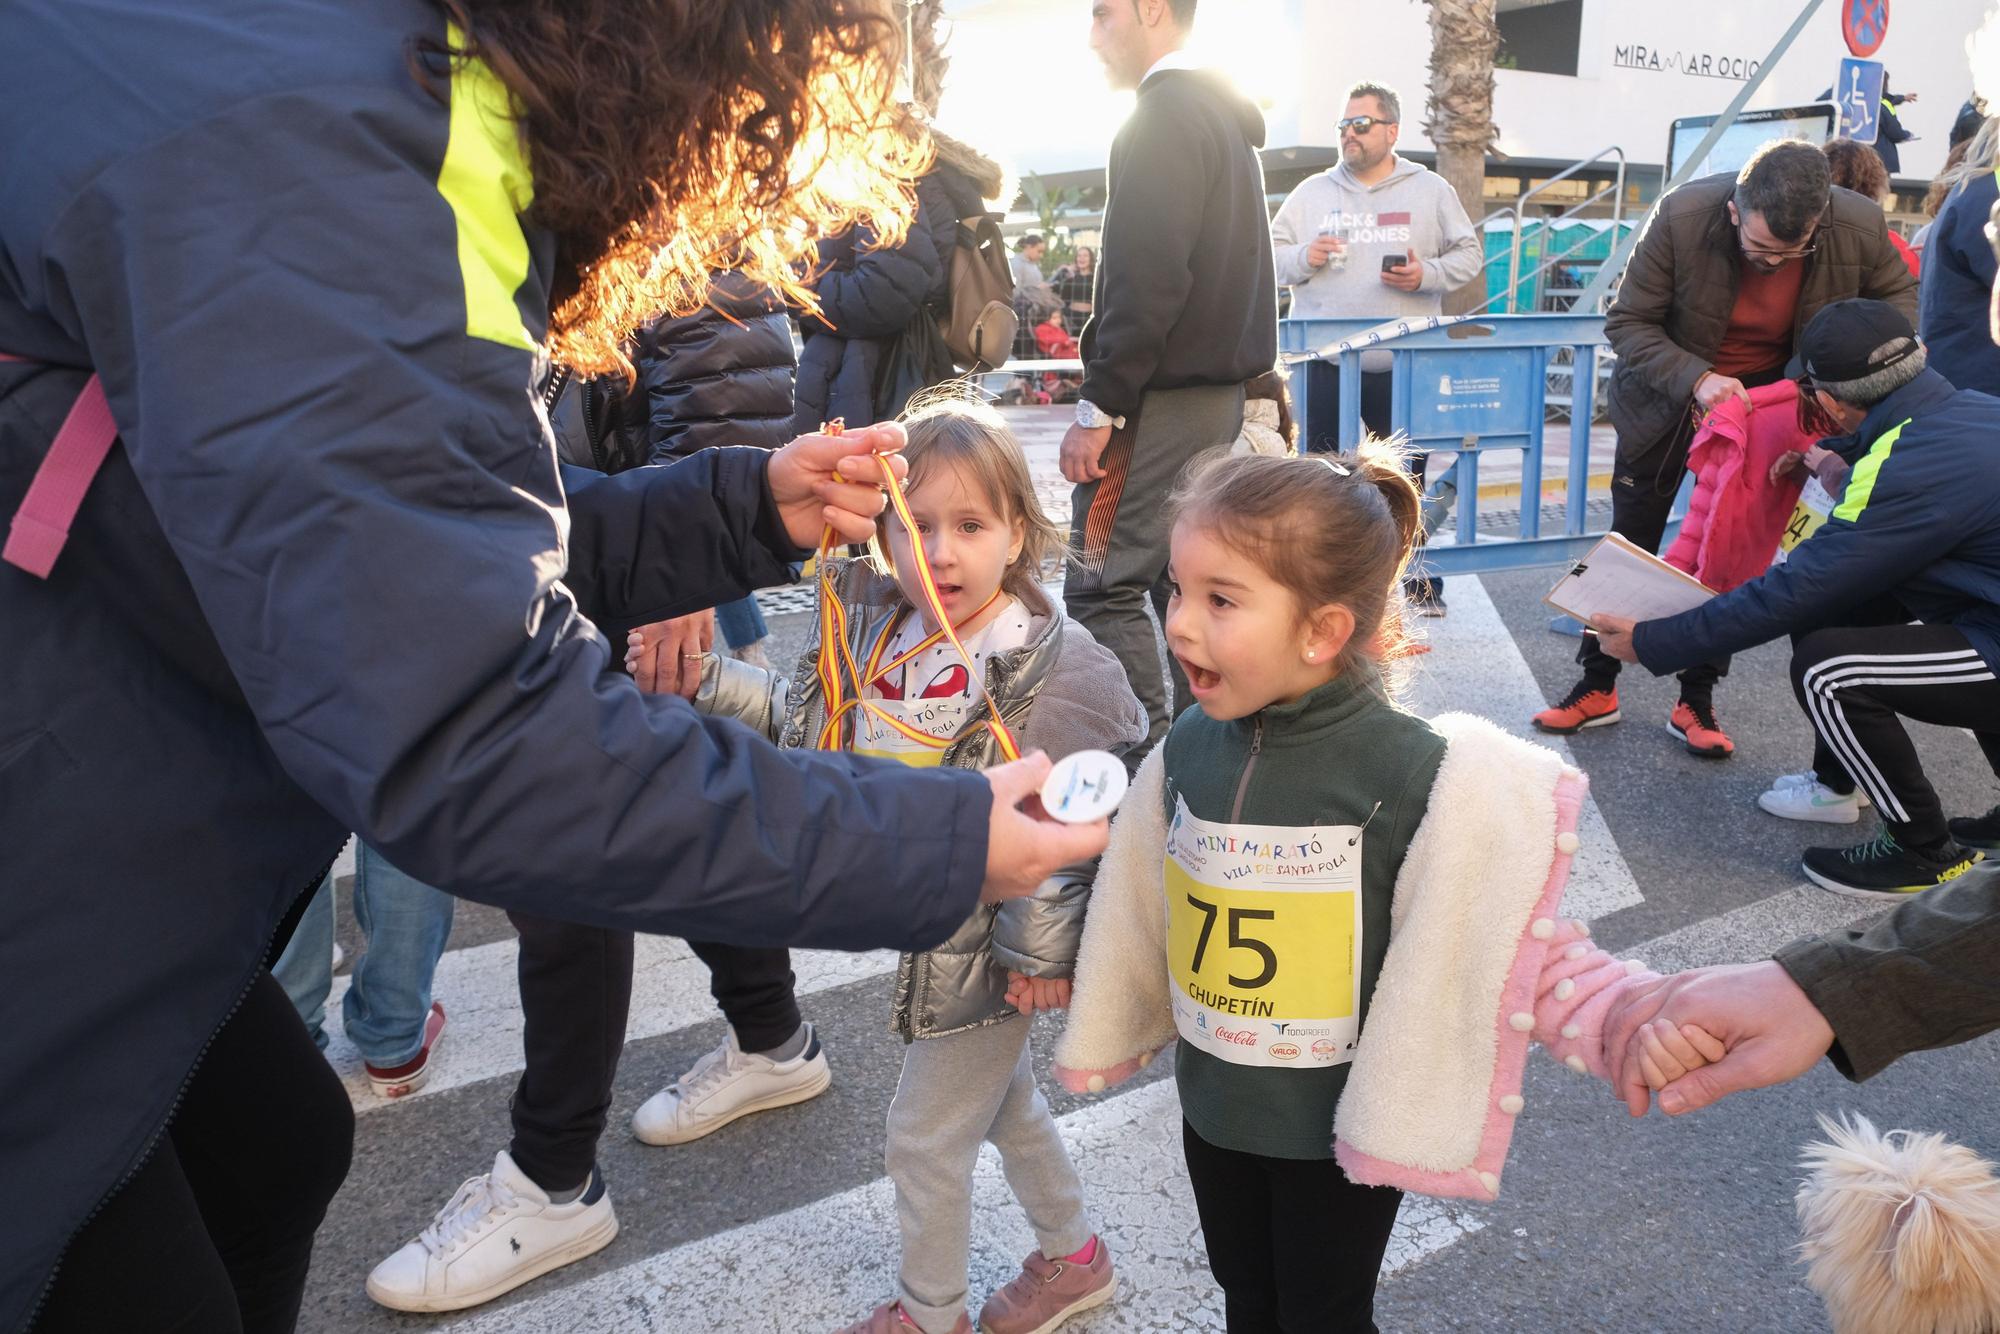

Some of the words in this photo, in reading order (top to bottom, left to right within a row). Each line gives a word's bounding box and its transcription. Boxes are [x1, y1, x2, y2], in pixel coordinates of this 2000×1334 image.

[1349, 227, 1411, 243] JONES
[931, 720, 955, 736] POLA
[1197, 835, 1238, 854] MINI
[1241, 833, 1323, 860] MARATÓ
[1223, 864, 1253, 881] VILA
[1255, 864, 1273, 876] DE
[1276, 864, 1315, 877] SANTA
[1317, 853, 1348, 874] POLA
[1936, 859, 1973, 884] HOKA
[1186, 892, 1279, 990] 75
[1188, 982, 1275, 1018] CHUPETÍN
[1271, 1048, 1298, 1057] VALOR
